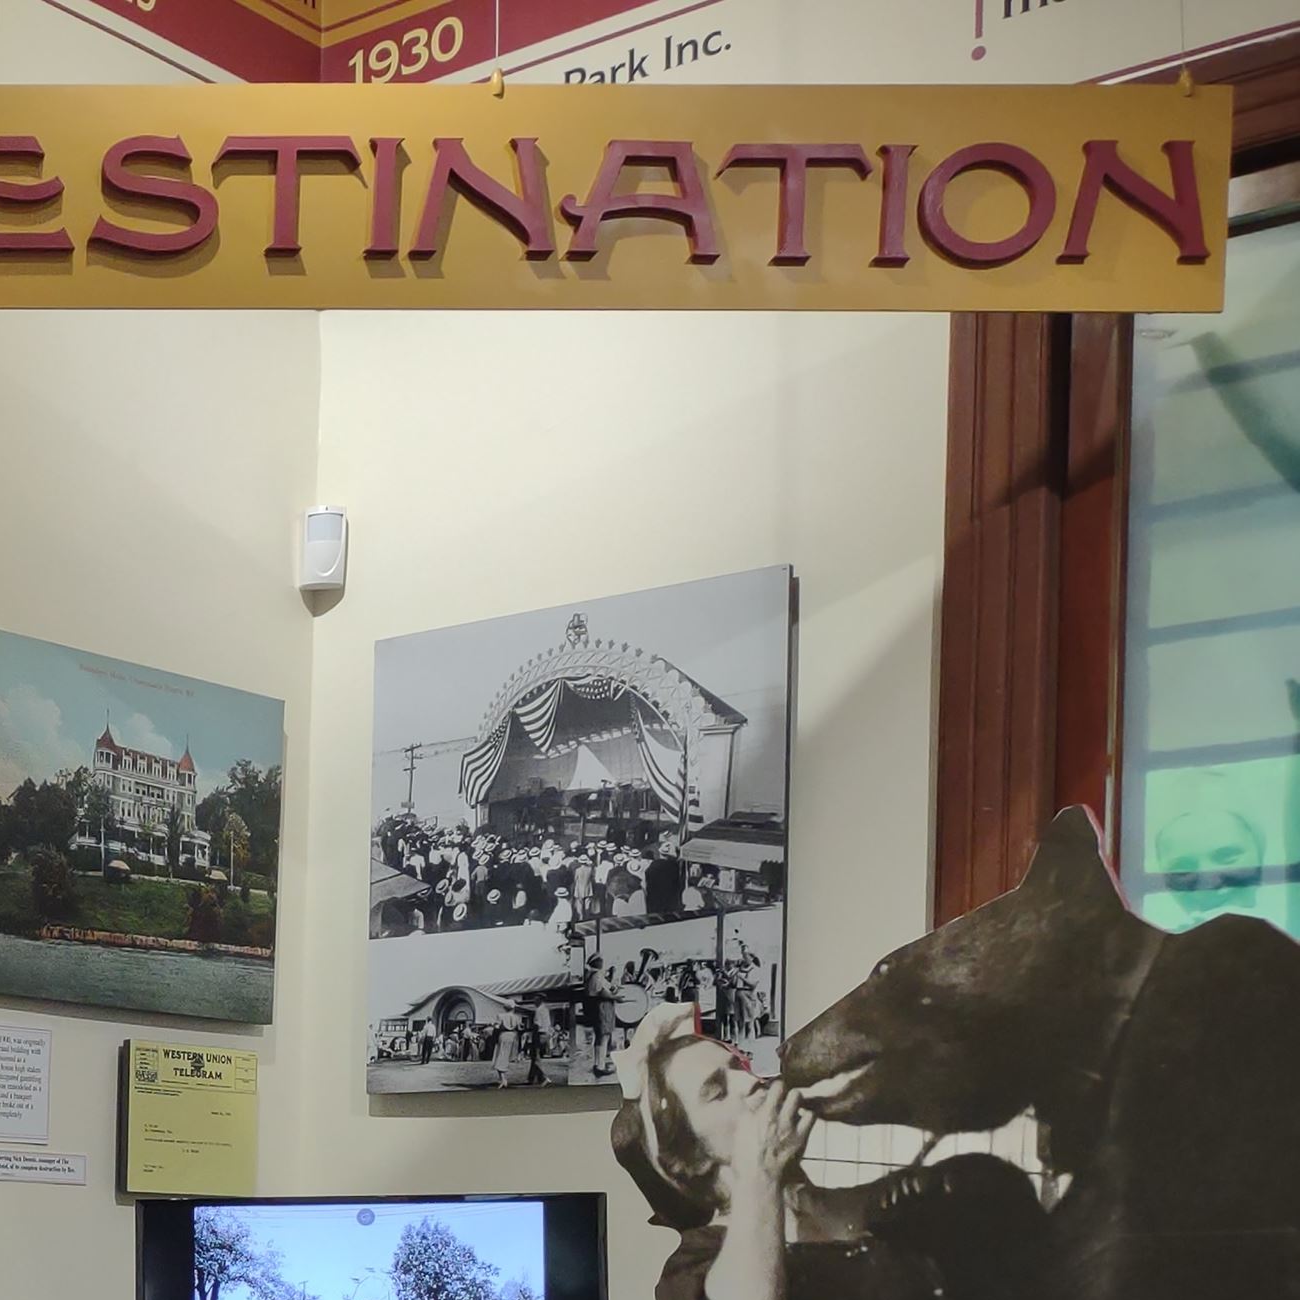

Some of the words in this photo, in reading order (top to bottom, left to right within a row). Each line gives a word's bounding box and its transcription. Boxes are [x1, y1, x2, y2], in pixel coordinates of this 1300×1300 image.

[348, 16, 464, 84] 1930
[663, 30, 732, 72] Inc.
[162, 1048, 204, 1062] WESTERN
[206, 1053, 232, 1065] UNION
[173, 1068, 223, 1080] TELEGRAM
